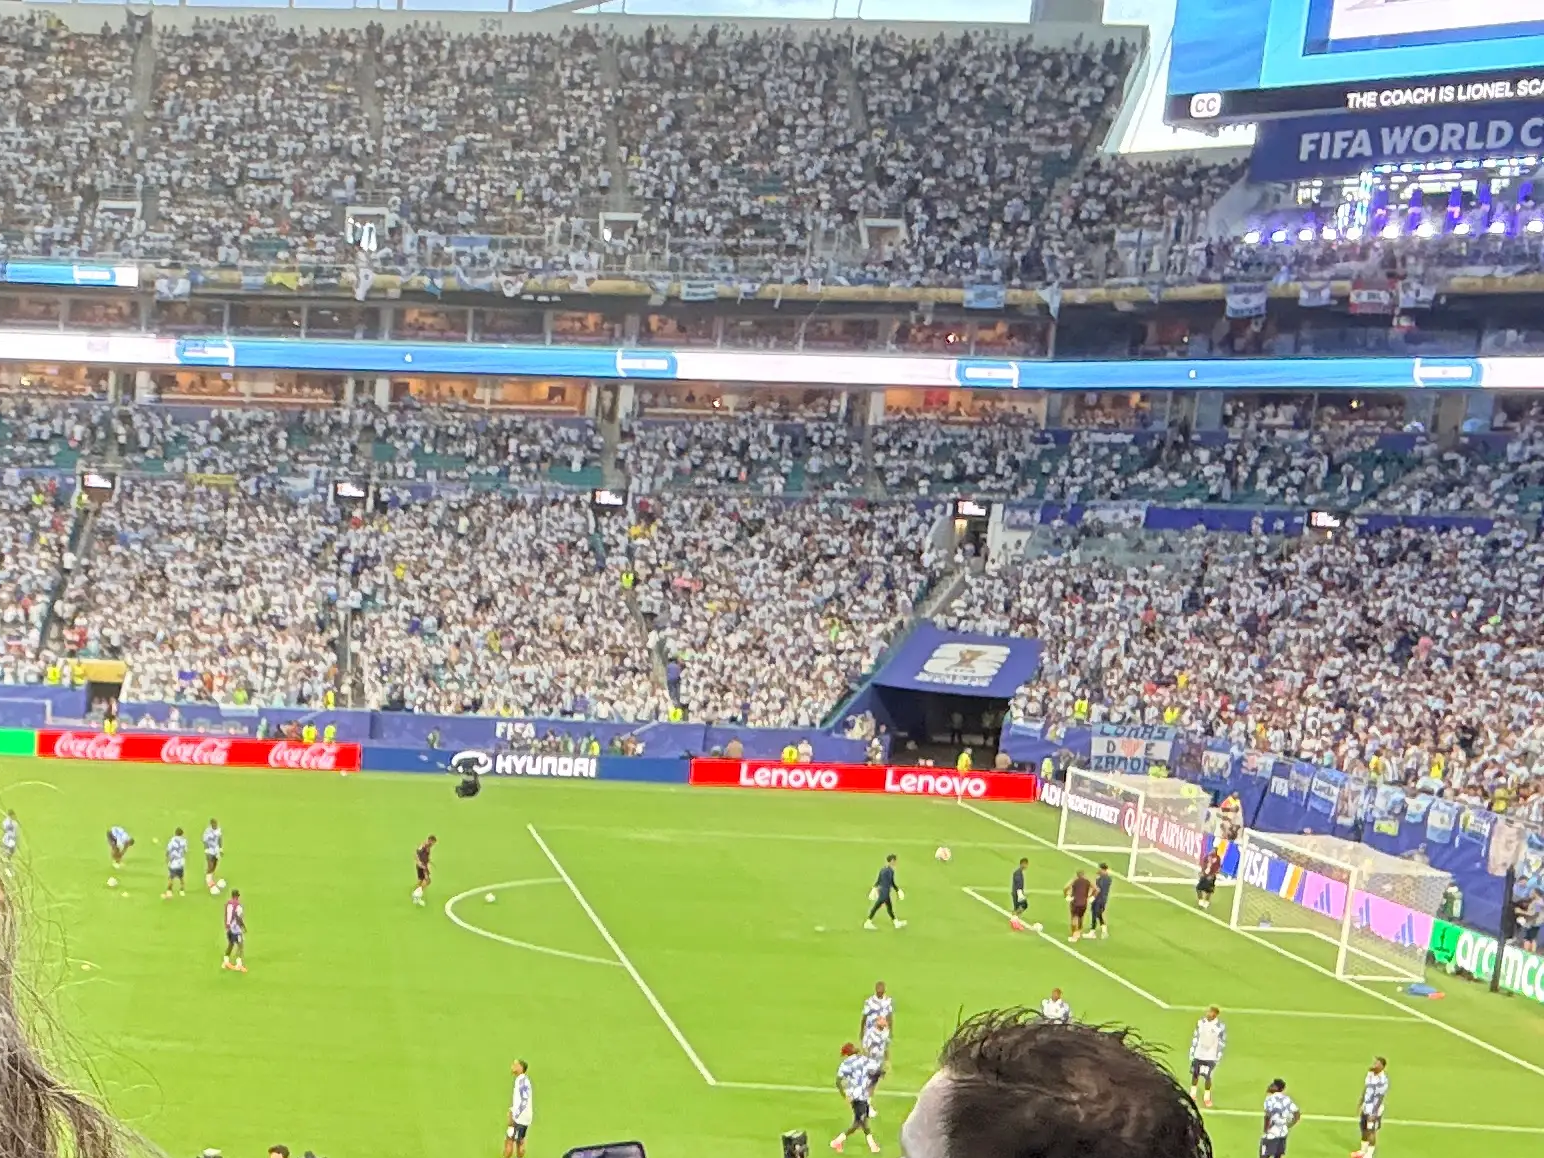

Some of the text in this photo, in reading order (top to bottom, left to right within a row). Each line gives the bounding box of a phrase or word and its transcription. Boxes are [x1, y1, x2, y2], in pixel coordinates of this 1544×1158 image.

[1347, 78, 1544, 109] THE COACH IS LIONEL SC
[1299, 128, 1373, 162] FIFA
[1381, 119, 1513, 155] WORLD
[495, 721, 536, 741] FIFA
[495, 753, 597, 778] HYUNDAI
[740, 763, 838, 790] Lenovo
[885, 769, 986, 797] Lenovo
